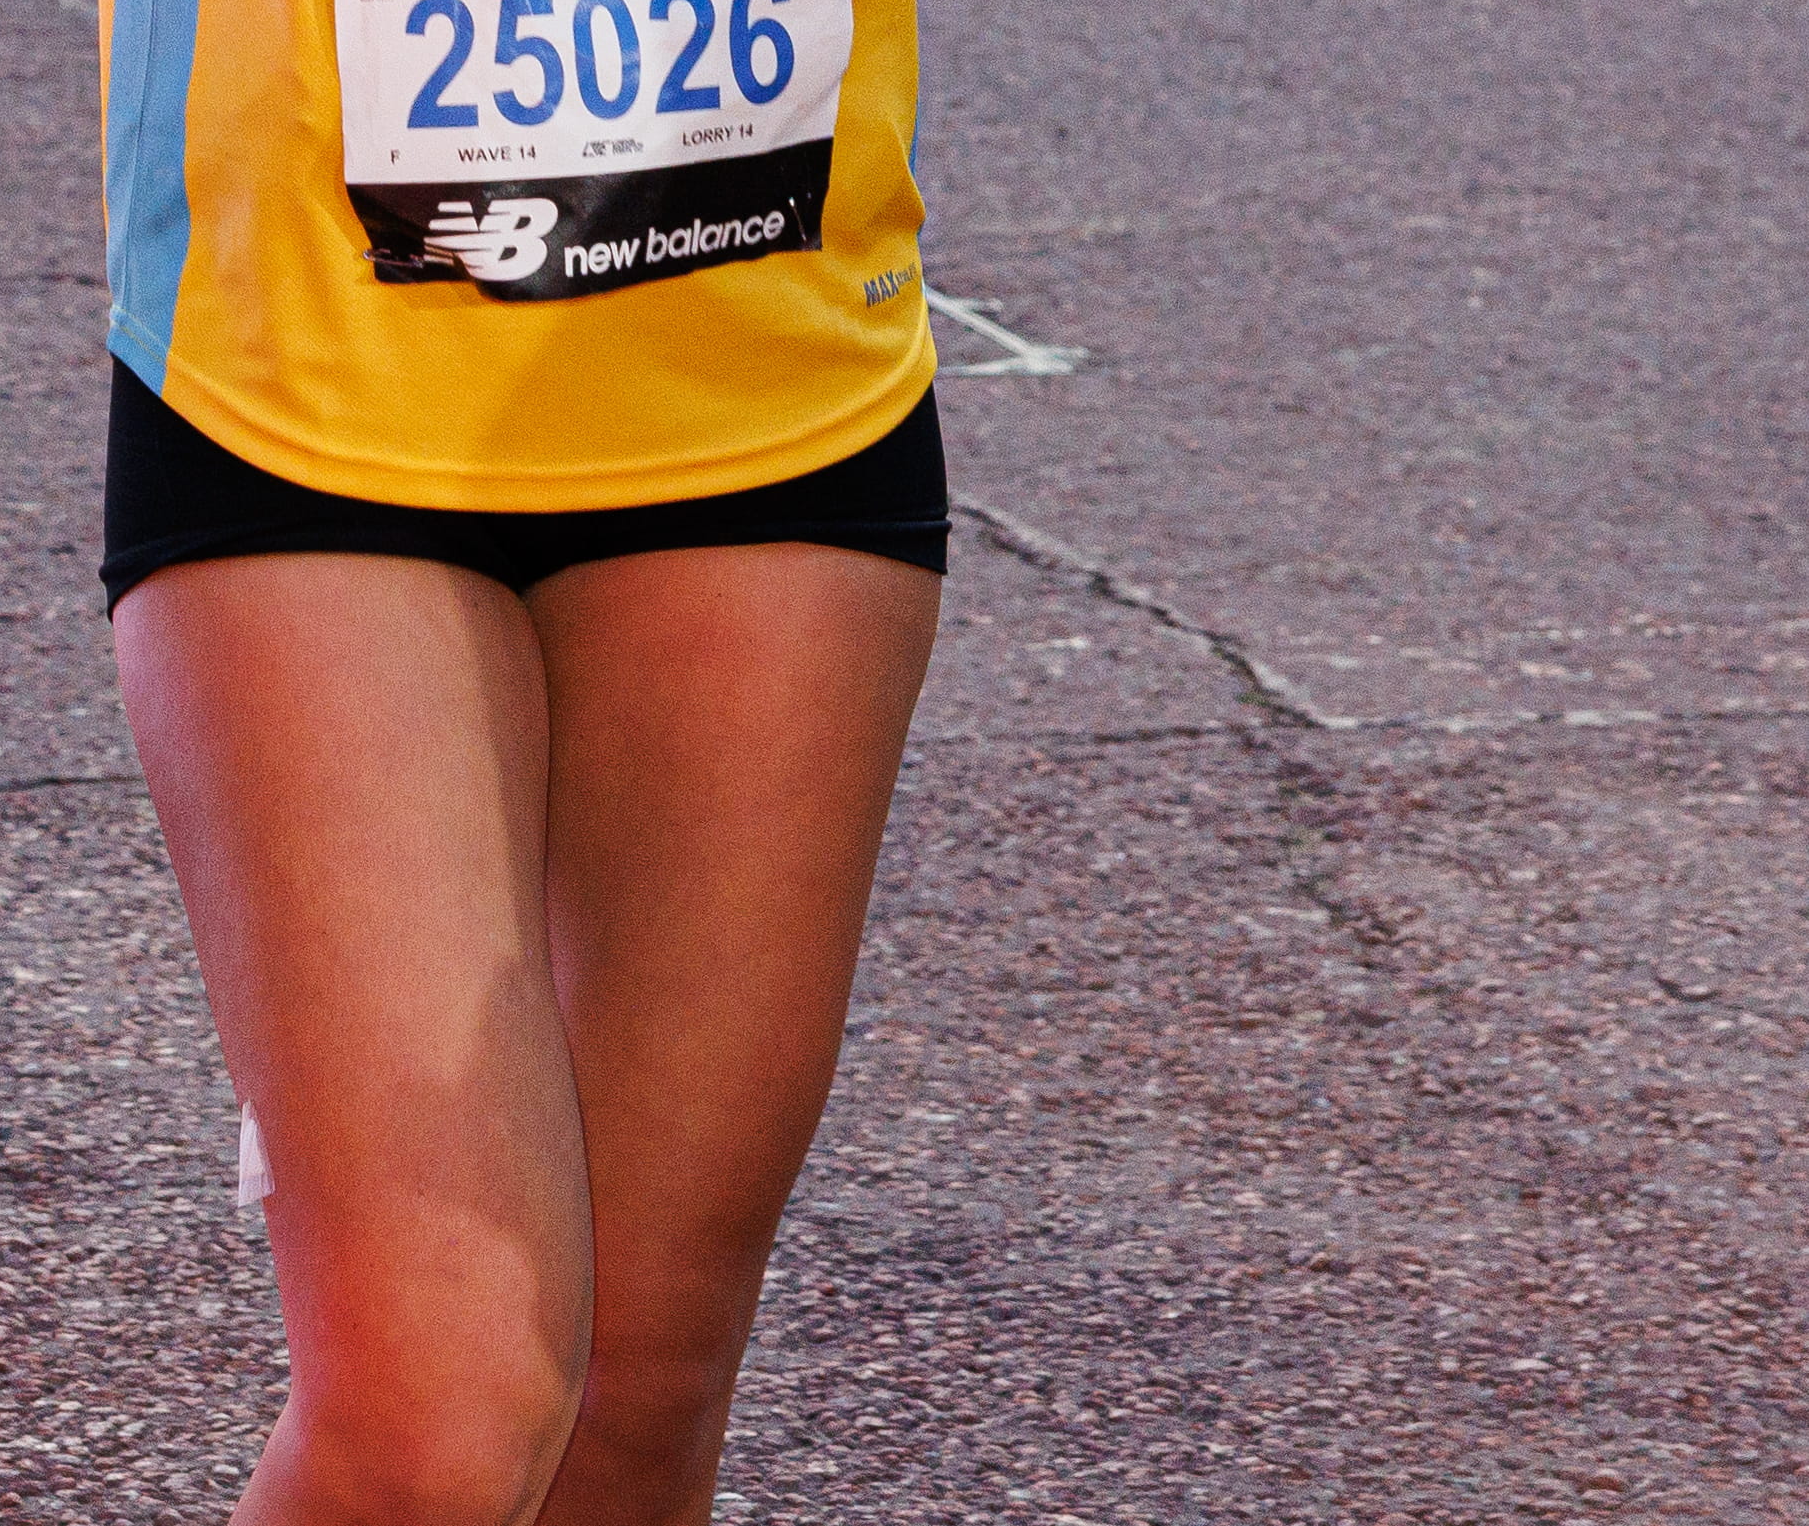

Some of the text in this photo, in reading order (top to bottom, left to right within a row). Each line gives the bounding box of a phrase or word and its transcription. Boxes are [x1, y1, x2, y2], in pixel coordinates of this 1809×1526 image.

[681, 123, 755, 147] LORRY 14
[391, 148, 401, 164] F
[457, 146, 537, 163] WAVE 14
[565, 238, 638, 275] new
[646, 209, 787, 264] balance
